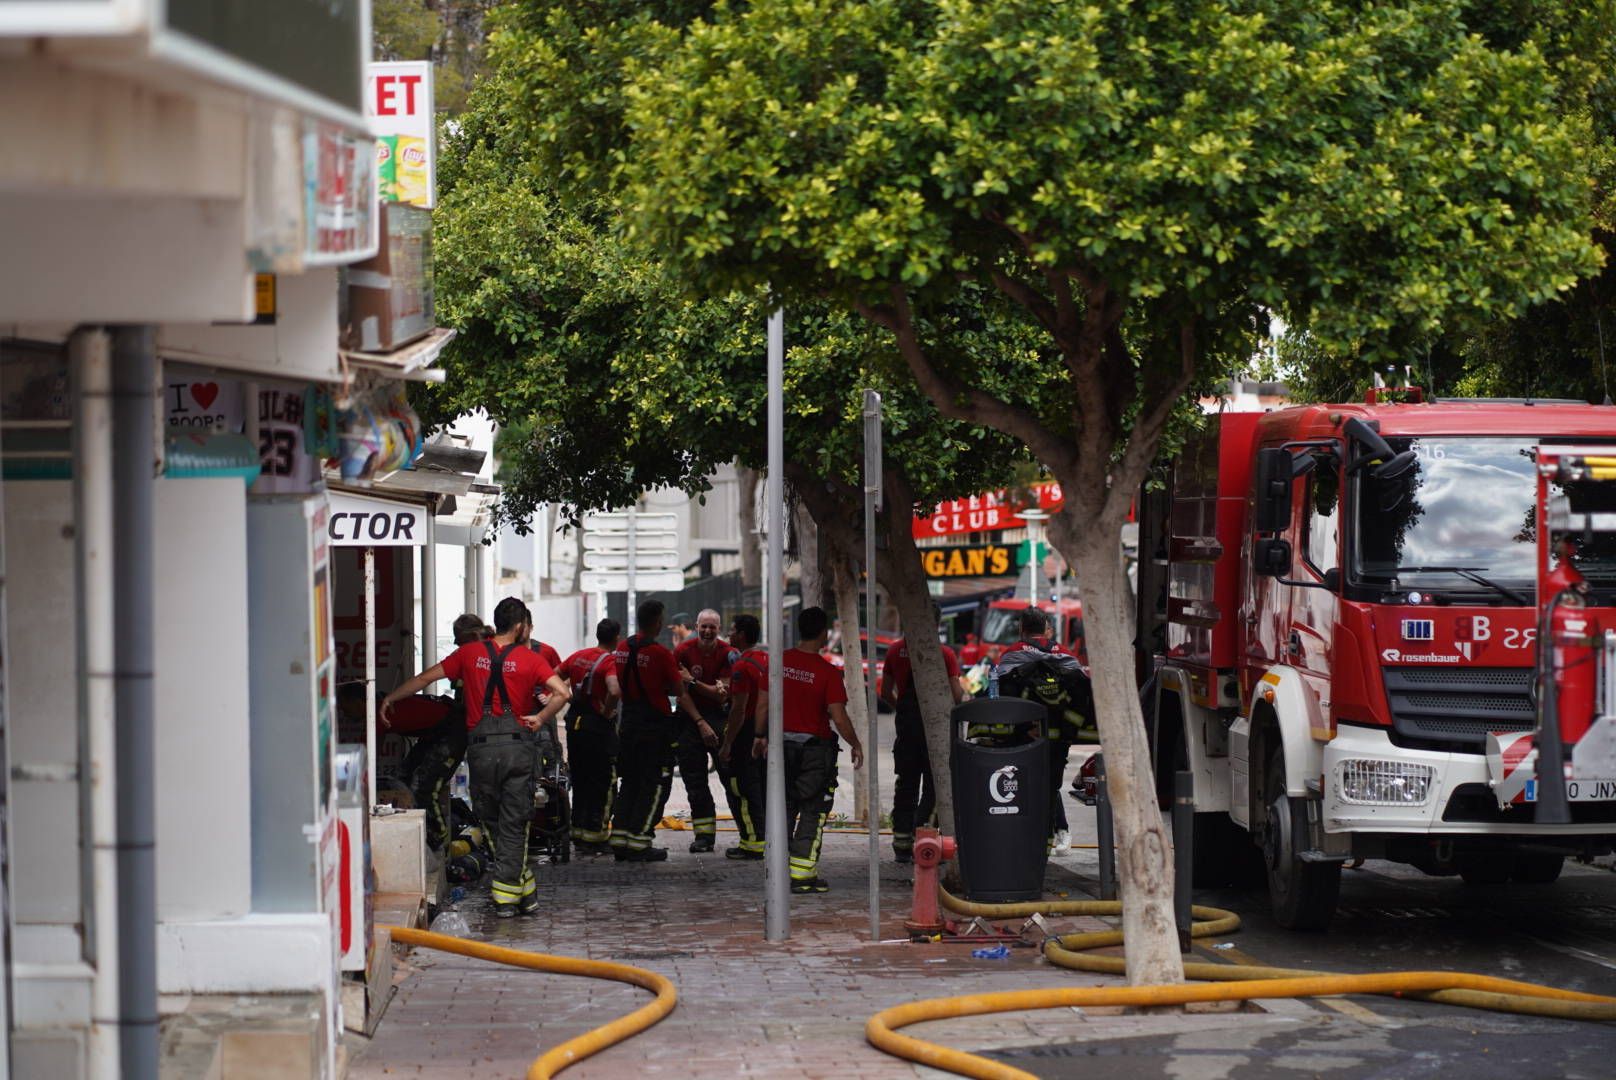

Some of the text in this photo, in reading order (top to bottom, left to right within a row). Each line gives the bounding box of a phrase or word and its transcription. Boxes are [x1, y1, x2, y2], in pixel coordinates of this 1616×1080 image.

[372, 75, 421, 115] ET
[328, 512, 416, 540] CTOR
[932, 509, 999, 533] CLUB
[922, 545, 1009, 577] GAN'S
[1402, 653, 1460, 663] rosenbauer
